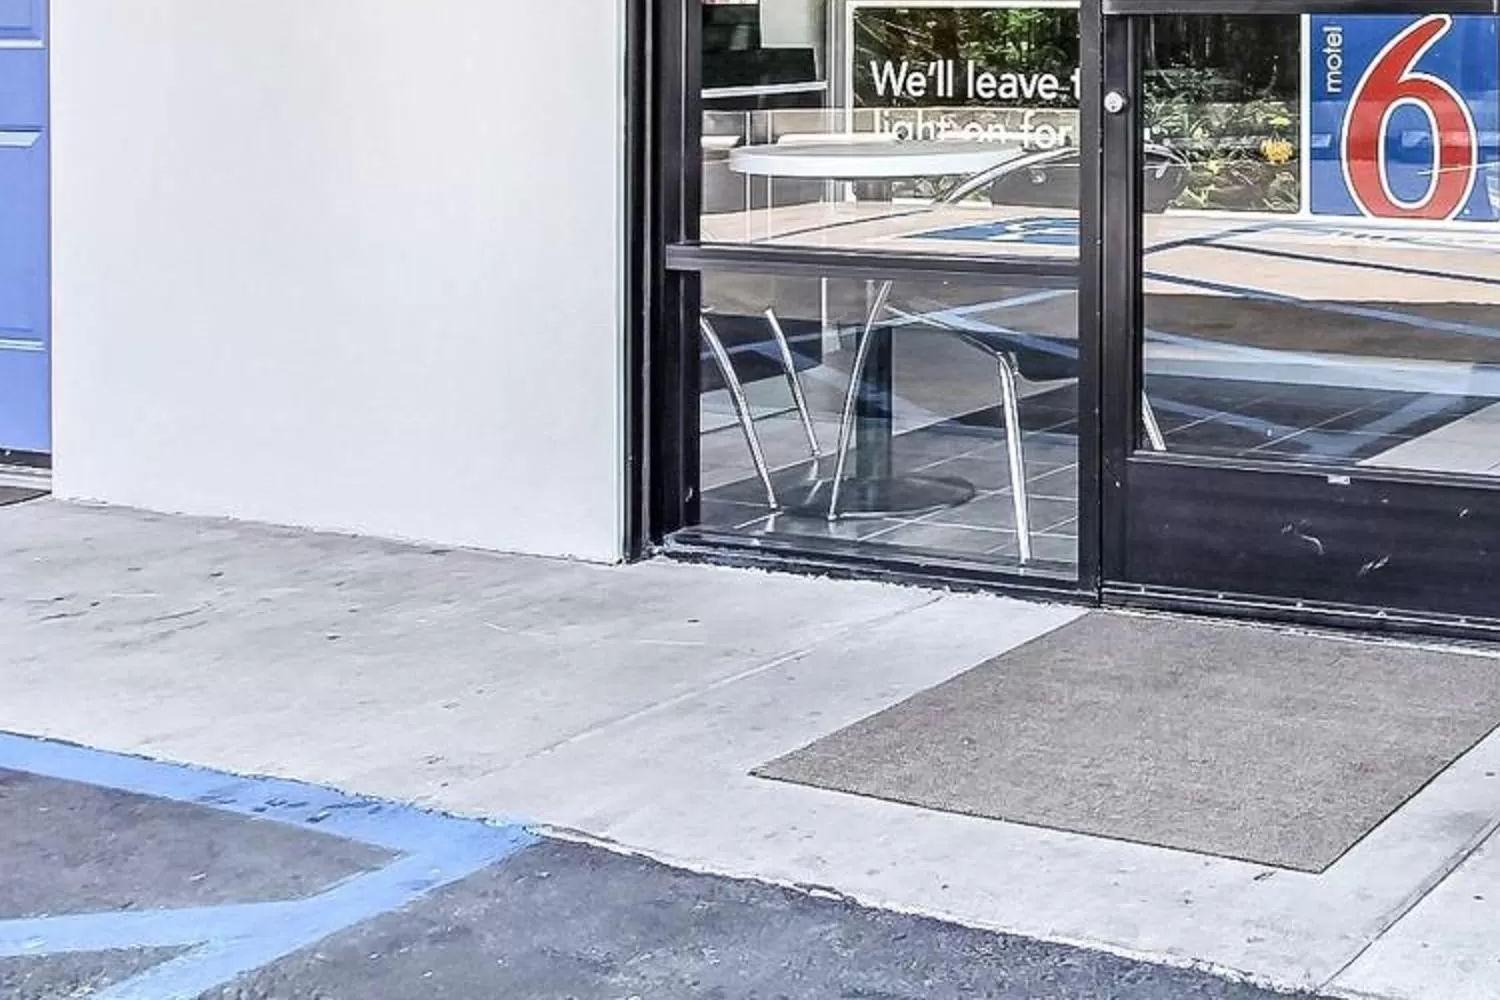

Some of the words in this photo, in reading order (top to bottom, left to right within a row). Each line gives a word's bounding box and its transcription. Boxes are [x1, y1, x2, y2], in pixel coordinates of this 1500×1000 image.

[870, 60, 953, 98] We'll
[967, 60, 1060, 99] leave
[874, 108, 951, 143] light
[963, 119, 1006, 143] on
[1020, 110, 1073, 150] for
[1322, 26, 1343, 93] motel
[1340, 14, 1479, 220] 6
